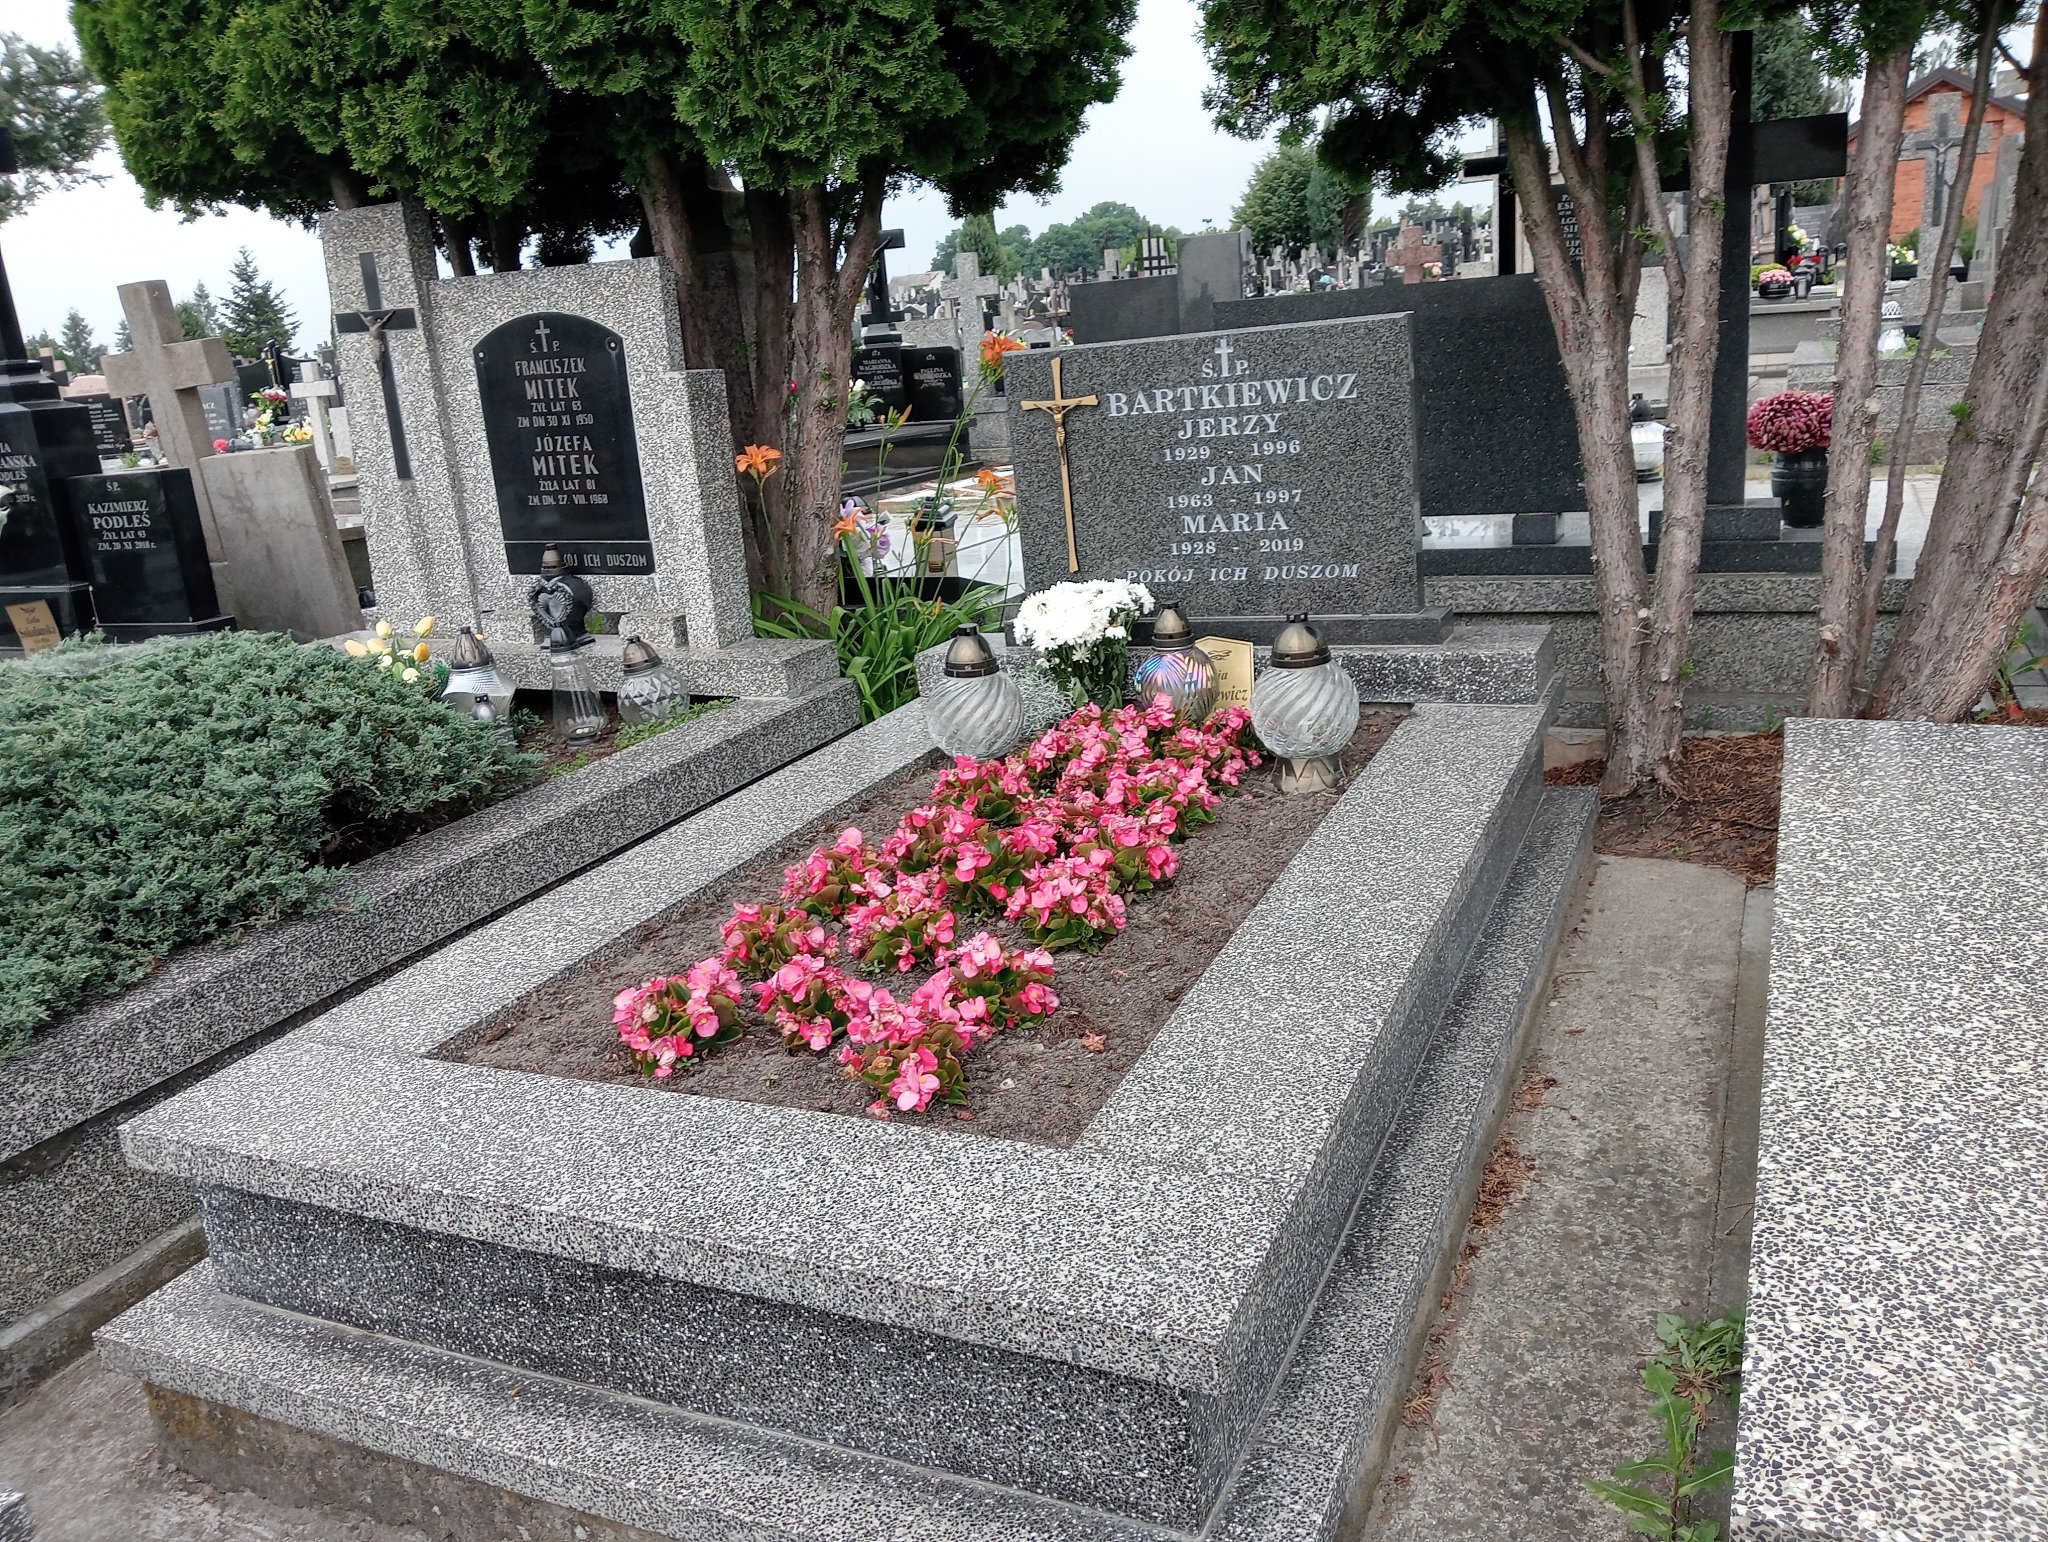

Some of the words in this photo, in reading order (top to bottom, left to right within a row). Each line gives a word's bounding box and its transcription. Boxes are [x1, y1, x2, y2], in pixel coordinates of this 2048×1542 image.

[514, 357, 587, 377] FRANCISZEK
[1235, 360, 1250, 376] P.
[524, 377, 580, 400] MITEK
[1107, 373, 1358, 418] BARTKIEWICZ
[550, 401, 566, 412] LAT
[561, 414, 571, 426] XI
[1177, 413, 1282, 439] JERZY
[534, 432, 593, 452] JÓZEFA
[1164, 446, 1211, 461] 1929
[1251, 440, 1300, 456] 1996
[532, 454, 599, 476] MITEK
[1200, 464, 1264, 486] JAN
[562, 479, 580, 490] LAT
[87, 500, 149, 514] KAZIMIERZ
[1167, 493, 1214, 509] 1963
[1253, 489, 1302, 505] 1997
[92, 511, 151, 530] PODLEŚ
[1181, 511, 1290, 534] MARIA
[120, 531, 135, 540] LAT
[1170, 541, 1217, 556] 1928
[1259, 538, 1304, 553] 2019
[583, 554, 600, 567] ICH
[606, 553, 647, 567] DUSZOM
[1125, 566, 1195, 583] POKÓJ
[1208, 567, 1249, 581] ICH
[1264, 563, 1360, 581] DUSZOM
